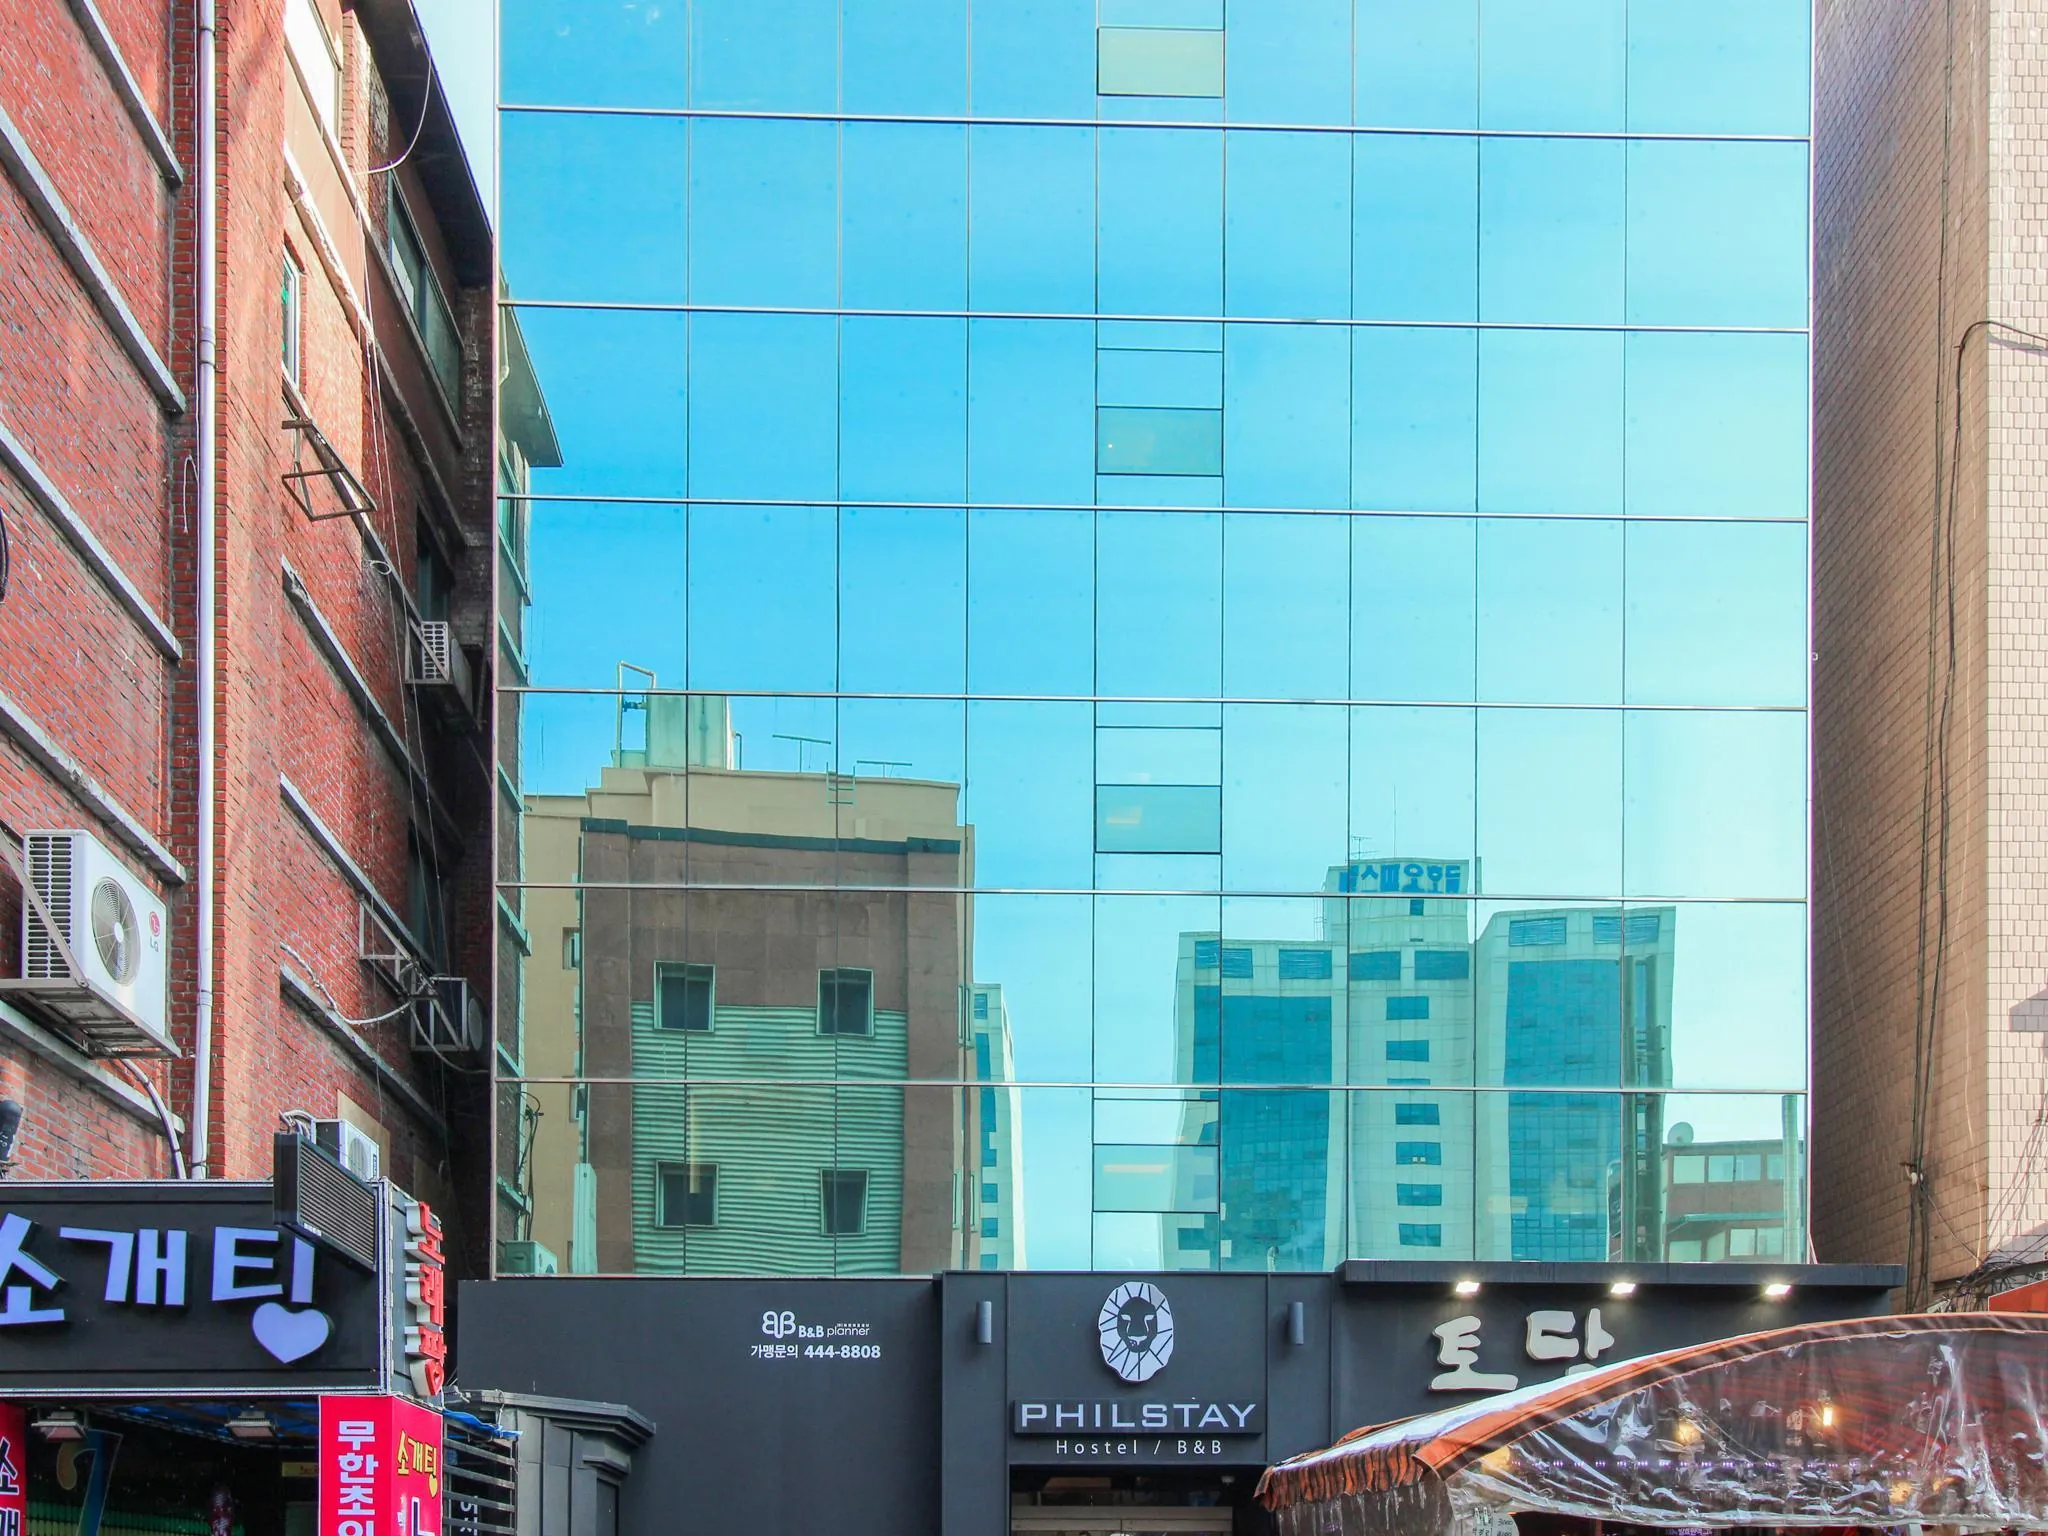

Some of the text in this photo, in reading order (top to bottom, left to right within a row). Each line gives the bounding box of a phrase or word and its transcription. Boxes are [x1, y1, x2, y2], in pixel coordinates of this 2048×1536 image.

[798, 1325, 824, 1337] B&B
[827, 1326, 870, 1338] planner
[751, 1344, 881, 1358] 가맹문의 444-8808
[1021, 1403, 1256, 1428] PHILSTAY
[1056, 1440, 1137, 1454] Hostel
[1178, 1440, 1222, 1454] B&B
